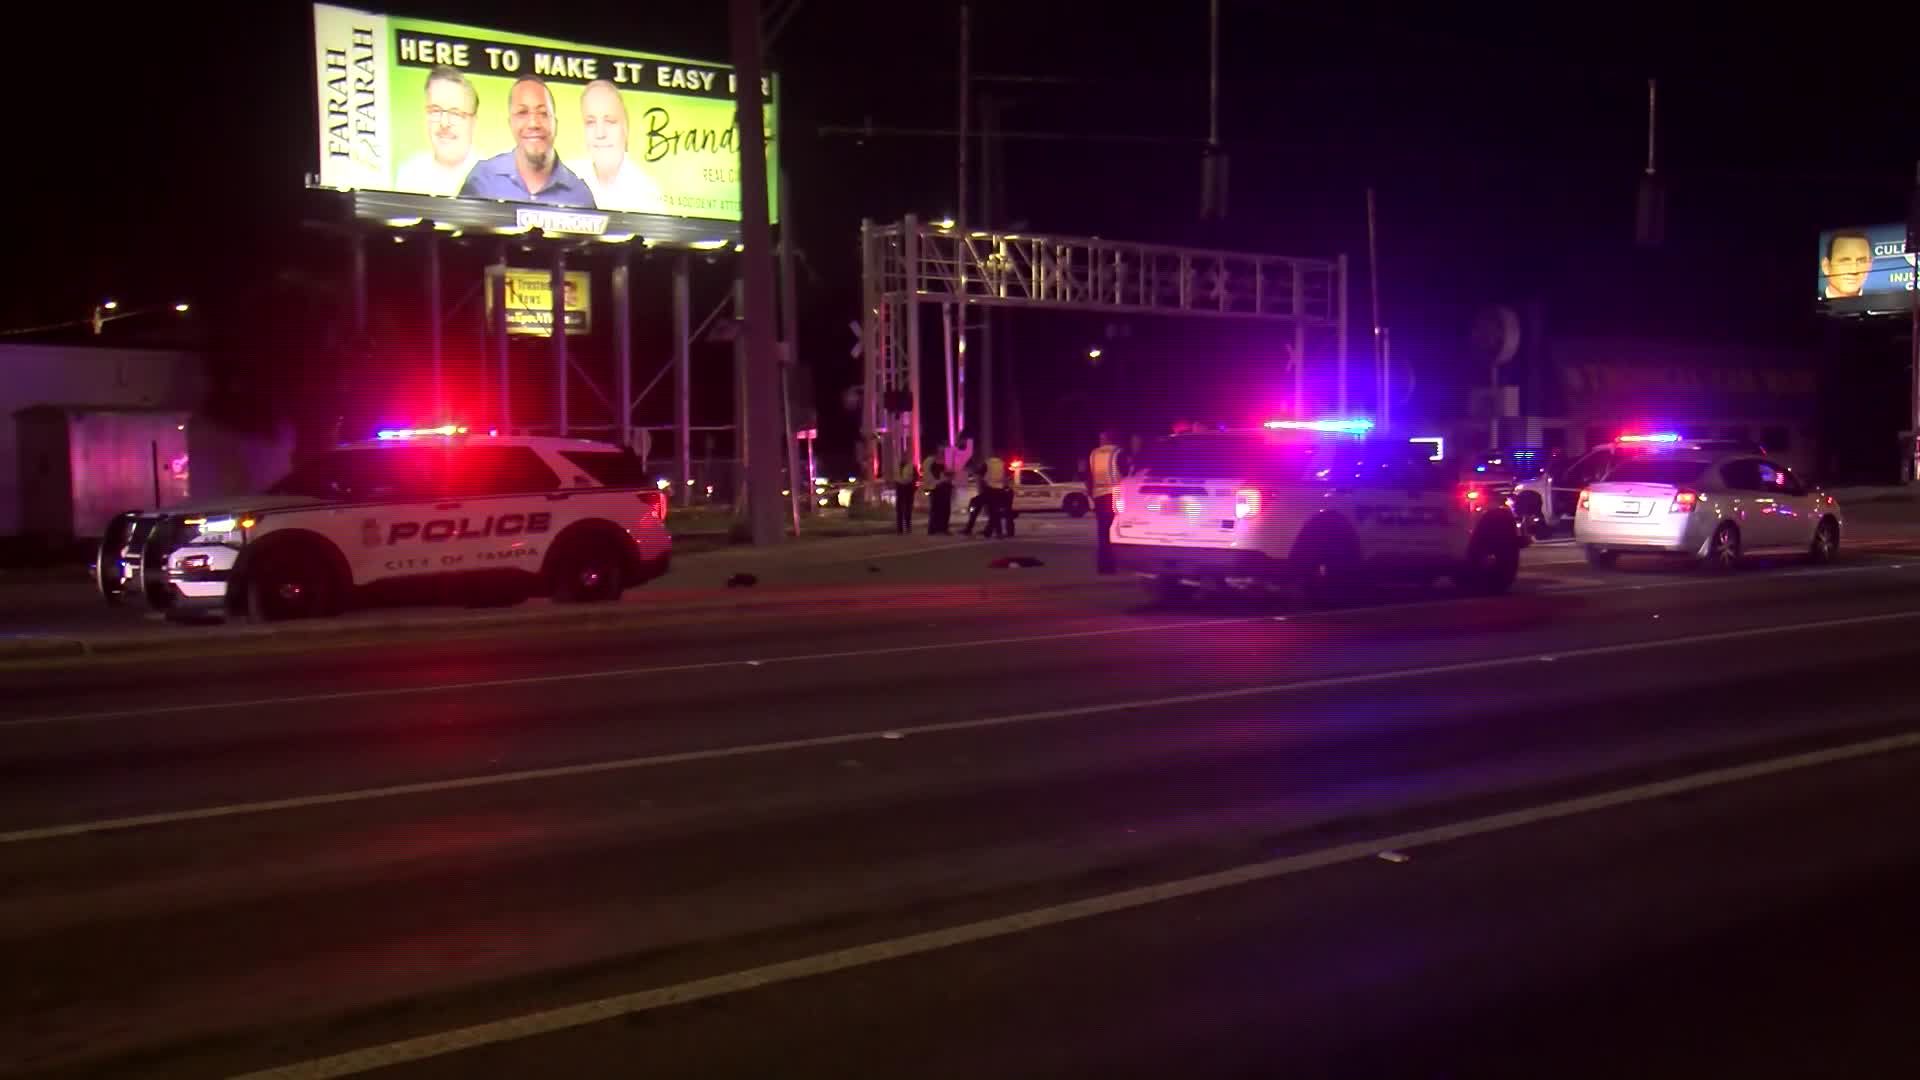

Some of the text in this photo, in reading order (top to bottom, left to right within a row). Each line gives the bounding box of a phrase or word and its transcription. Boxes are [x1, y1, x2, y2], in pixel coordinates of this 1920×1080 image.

[352, 26, 376, 137] FARAH
[400, 38, 470, 67] HERE
[485, 47, 520, 73] TO
[535, 53, 599, 80] MAKE
[614, 63, 643, 84] IT
[657, 66, 716, 91] EASY
[326, 48, 350, 160] FARAH
[387, 512, 552, 546] POLICE
[385, 547, 539, 571] CITY OF TAMPA
